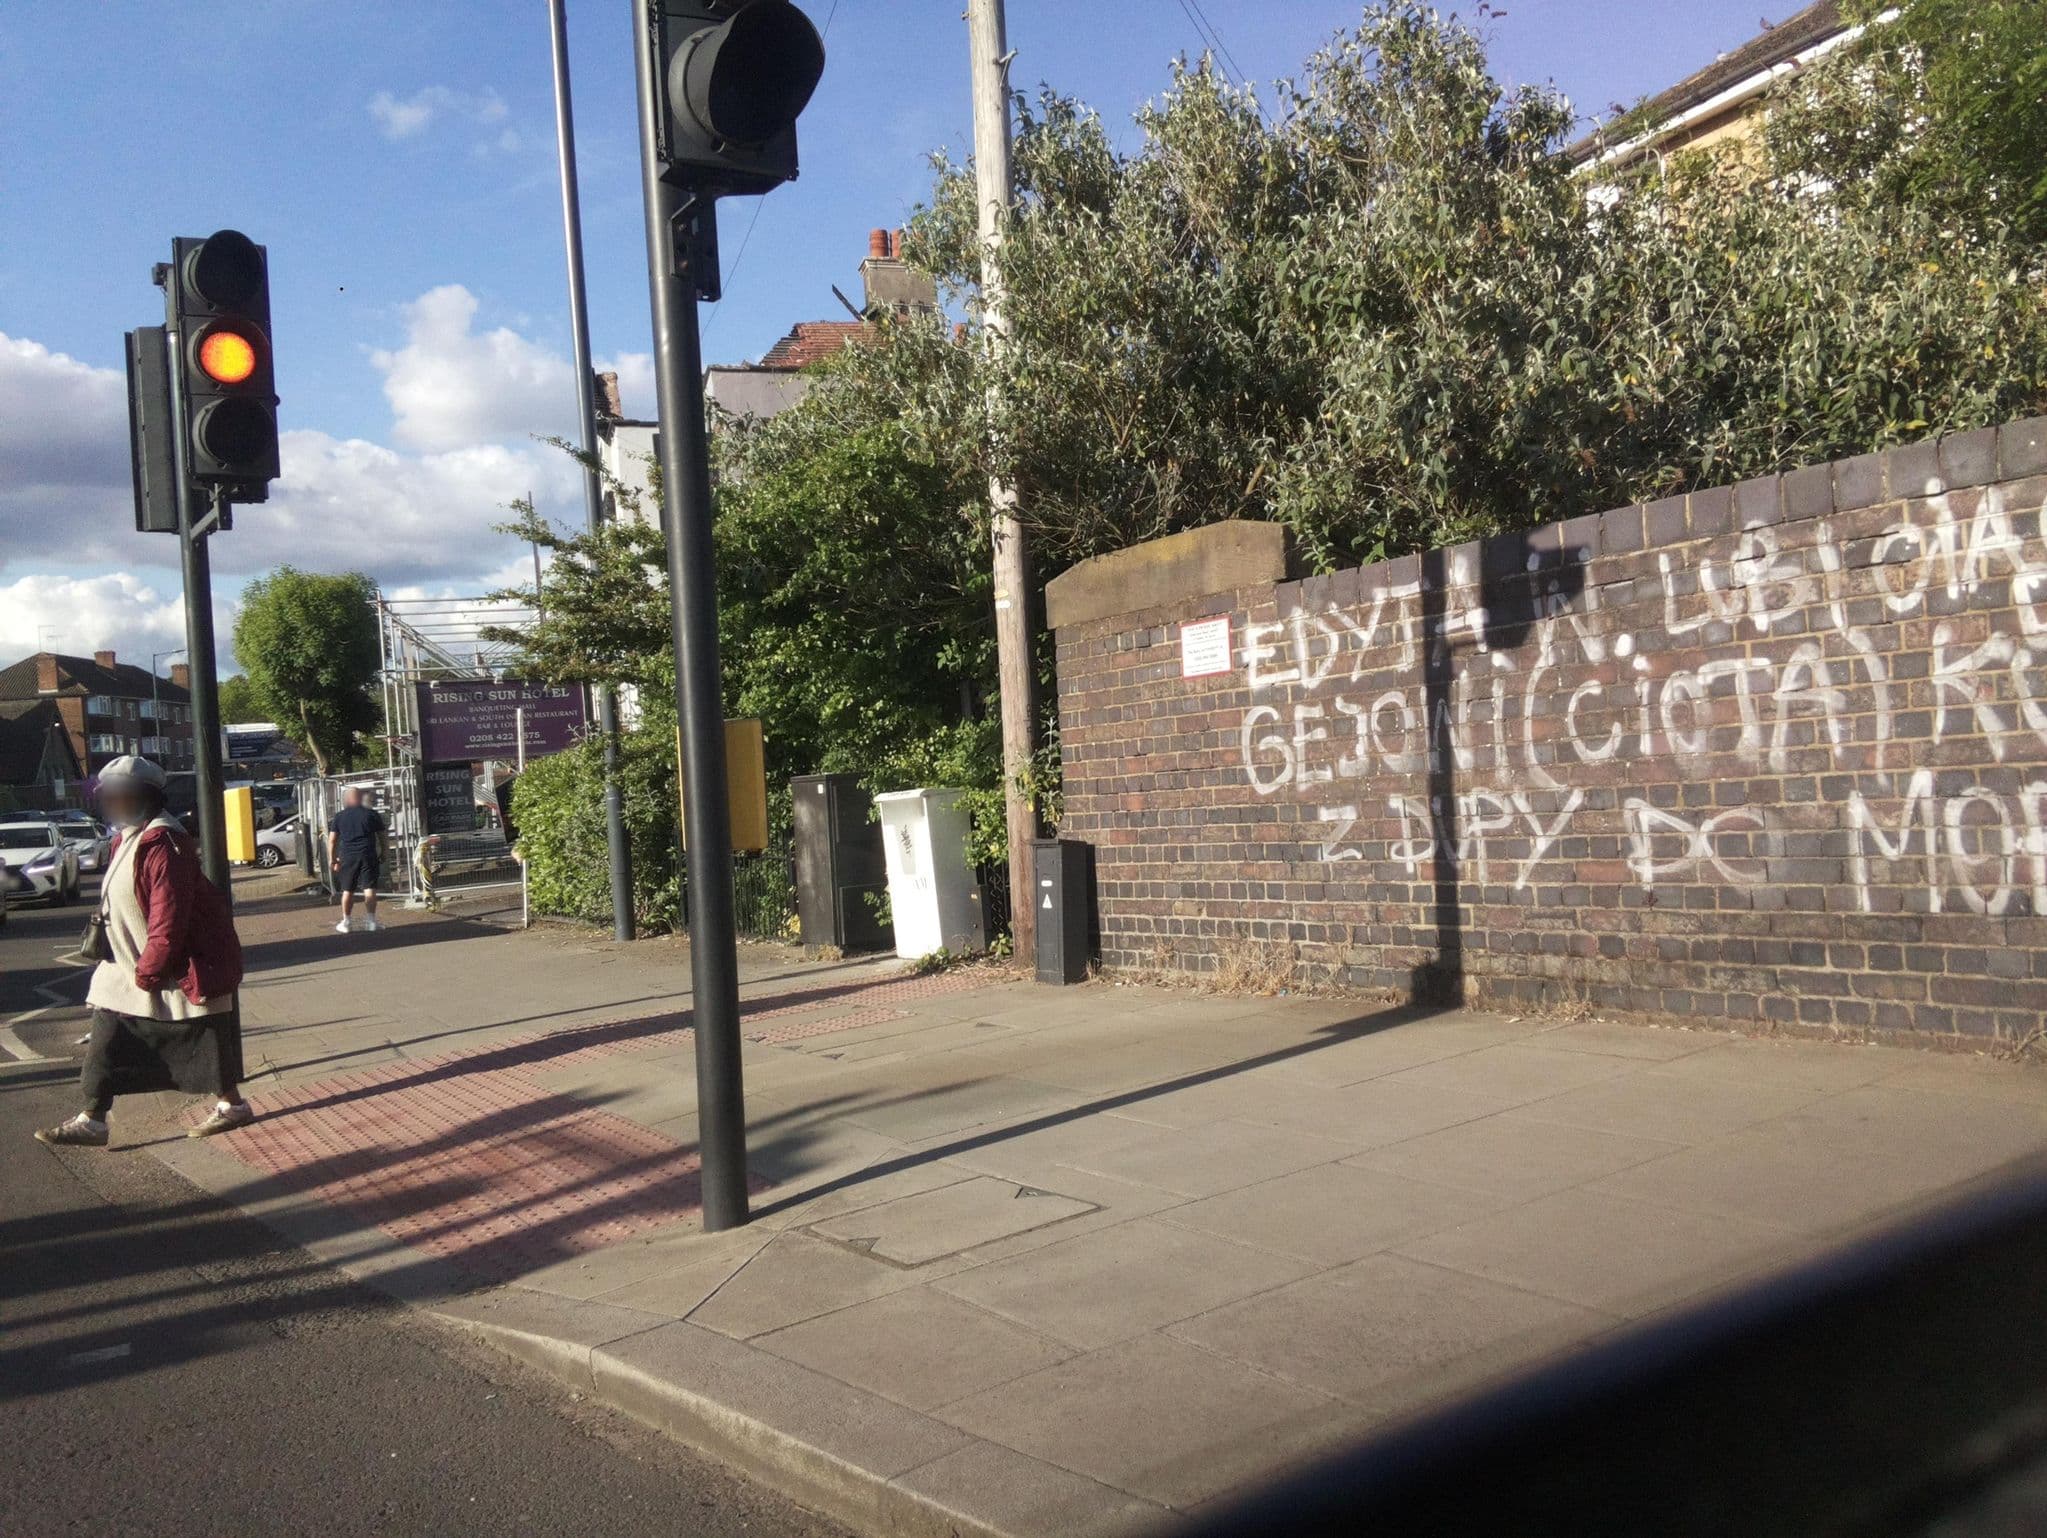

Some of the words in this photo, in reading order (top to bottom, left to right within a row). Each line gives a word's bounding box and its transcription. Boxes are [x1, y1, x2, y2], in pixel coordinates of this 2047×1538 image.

[1240, 553, 1489, 690] EDYTA
[432, 691, 484, 704] RISING
[488, 690, 517, 701] SUN
[521, 687, 570, 699] HOTEL
[534, 709, 579, 718] RESTAURANT
[496, 732, 514, 741] 422
[426, 769, 470, 782] RISING
[435, 783, 463, 794] SUN
[428, 796, 473, 808] HOTEL
